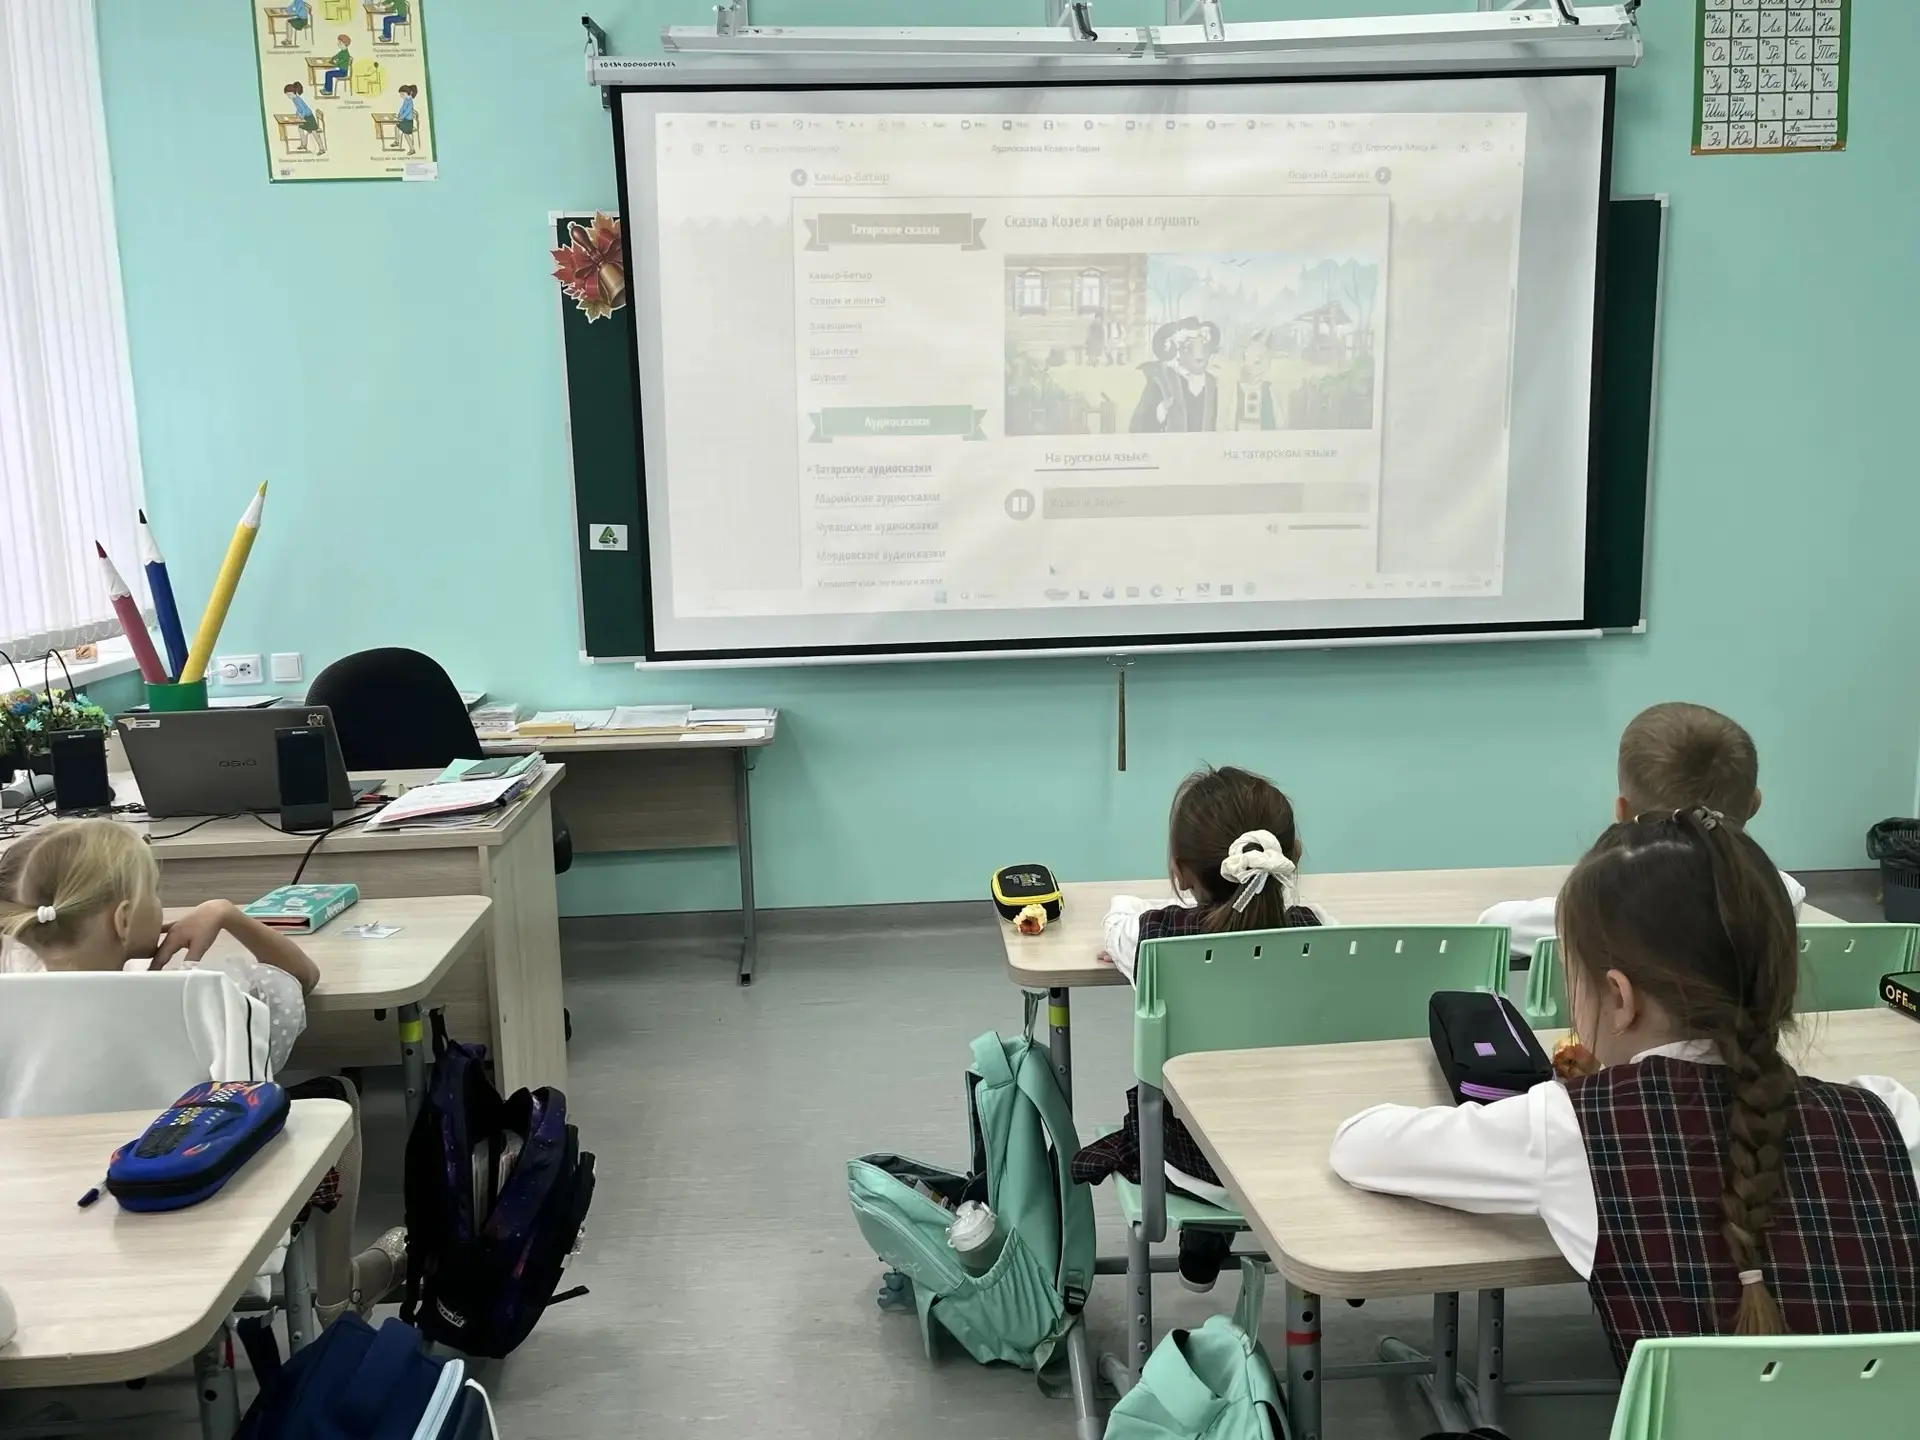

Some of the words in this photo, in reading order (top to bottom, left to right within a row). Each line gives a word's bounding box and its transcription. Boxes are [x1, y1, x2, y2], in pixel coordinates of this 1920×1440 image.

[1004, 215, 1048, 228] Сказка
[1051, 215, 1089, 228] Козел
[1092, 217, 1101, 227] и
[1105, 215, 1143, 230] баран
[1147, 216, 1202, 231] слушать
[851, 224, 902, 237] Татарские
[904, 225, 940, 235] сказки
[1045, 452, 1061, 463] На
[1063, 454, 1112, 465] русском
[1113, 452, 1149, 463] языке
[1223, 449, 1238, 459] На
[1240, 449, 1301, 460] татарском
[1303, 448, 1338, 459] языке
[814, 464, 865, 476] Татарские
[867, 464, 933, 476] аудиосказки
[876, 492, 941, 504] аудиосказки
[874, 521, 940, 534] аудиосказки
[882, 549, 947, 561] аудиосказки
